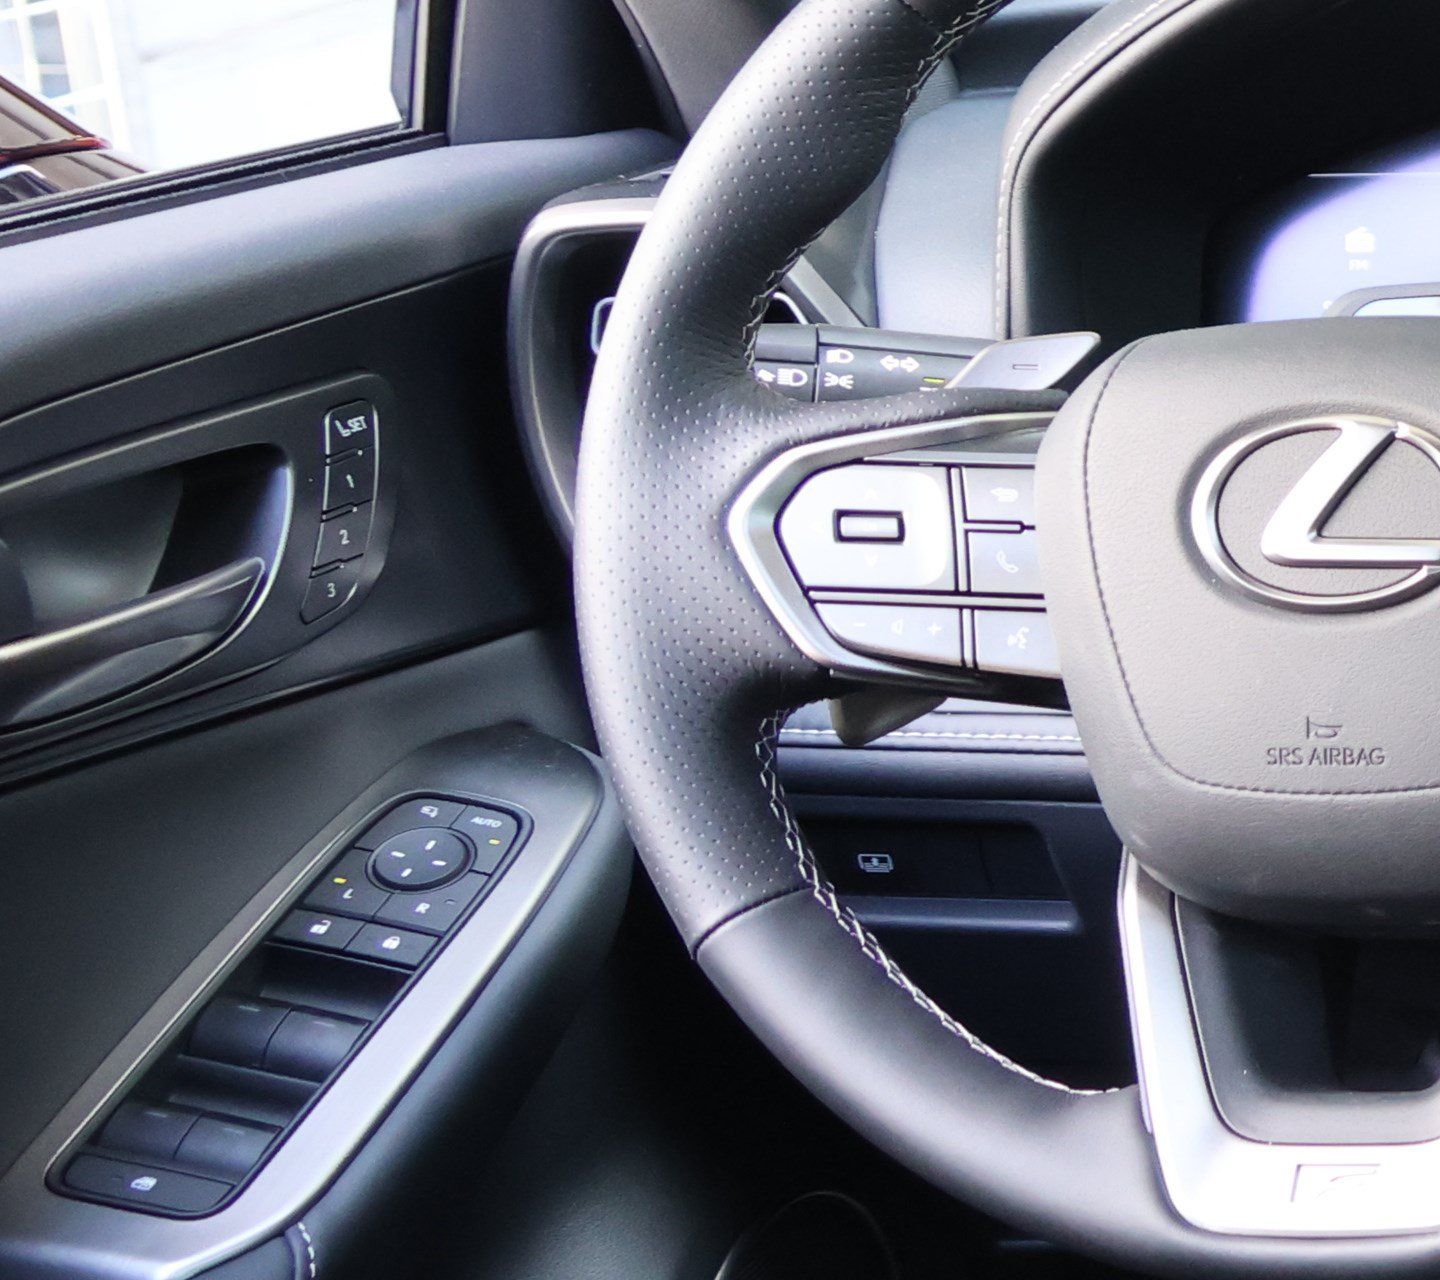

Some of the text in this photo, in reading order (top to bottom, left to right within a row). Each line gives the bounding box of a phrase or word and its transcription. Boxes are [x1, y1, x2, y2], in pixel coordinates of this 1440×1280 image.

[339, 529, 350, 545] 2
[327, 583, 336, 598] 3
[1266, 746, 1386, 766] SRS AIRBAG
[470, 816, 502, 828] AUTO
[415, 902, 430, 914] R
